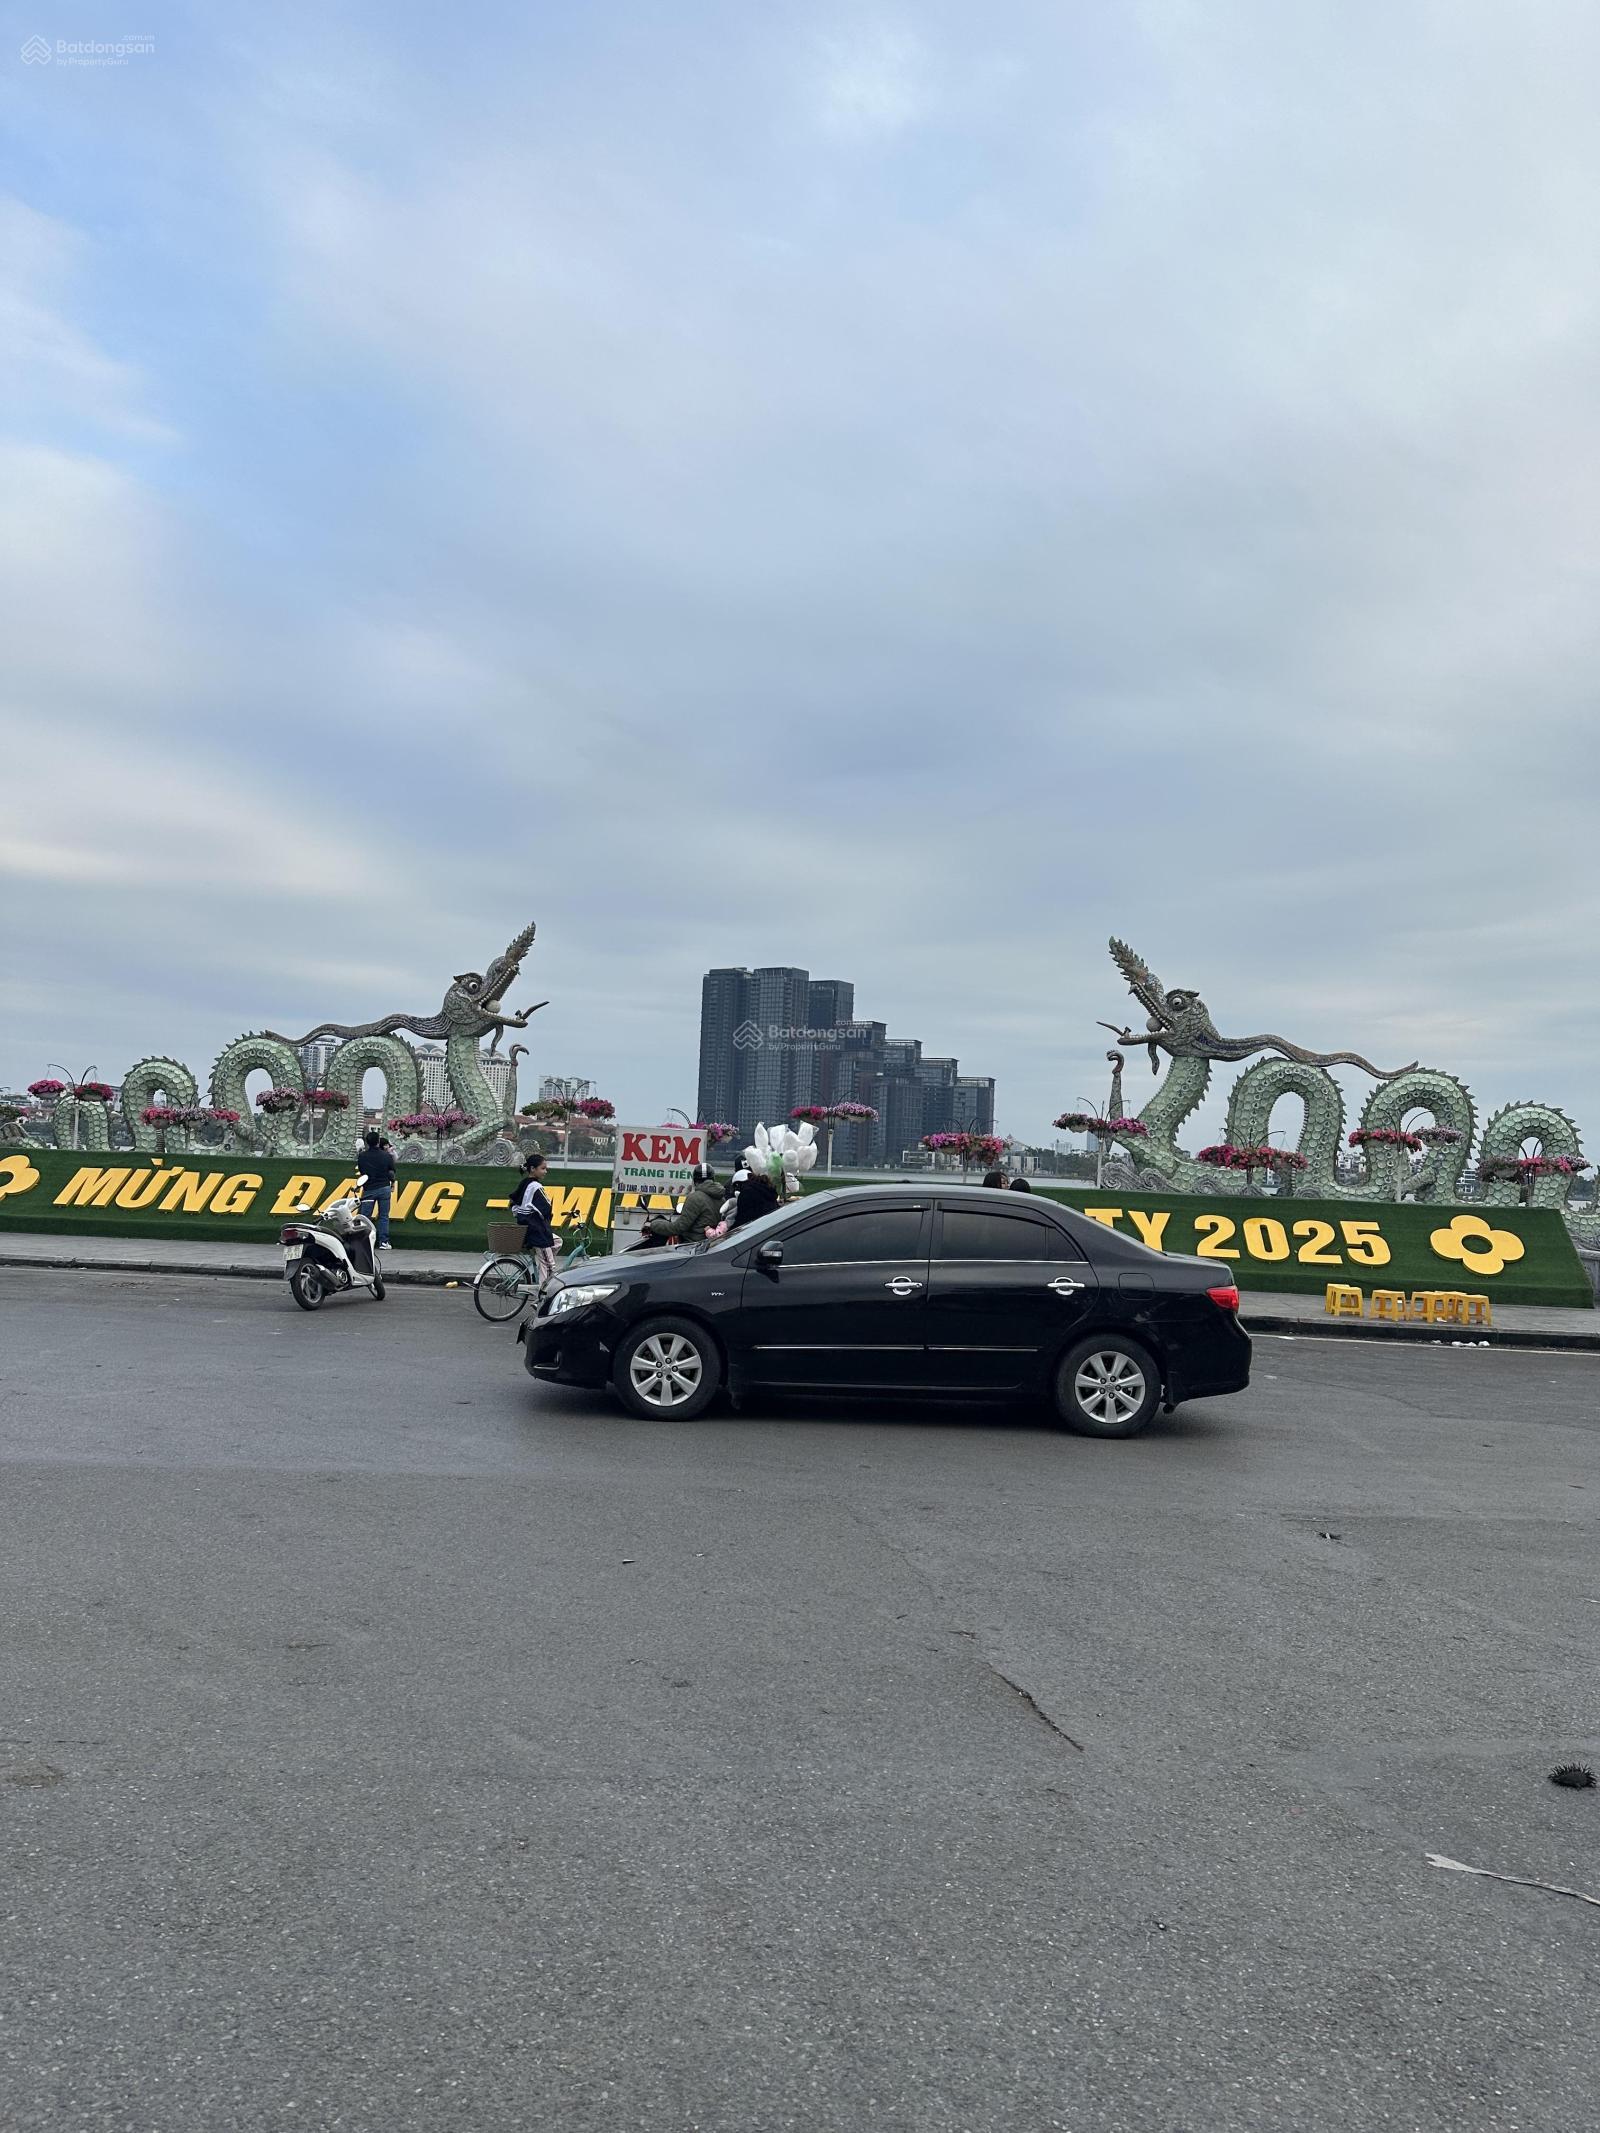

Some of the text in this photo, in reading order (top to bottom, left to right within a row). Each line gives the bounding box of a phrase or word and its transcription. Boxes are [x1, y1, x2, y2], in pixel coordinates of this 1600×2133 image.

[621, 1133, 702, 1165] KEM
[52, 1158, 263, 1214] MỪNG
[1193, 1214, 1391, 1266] 2025
